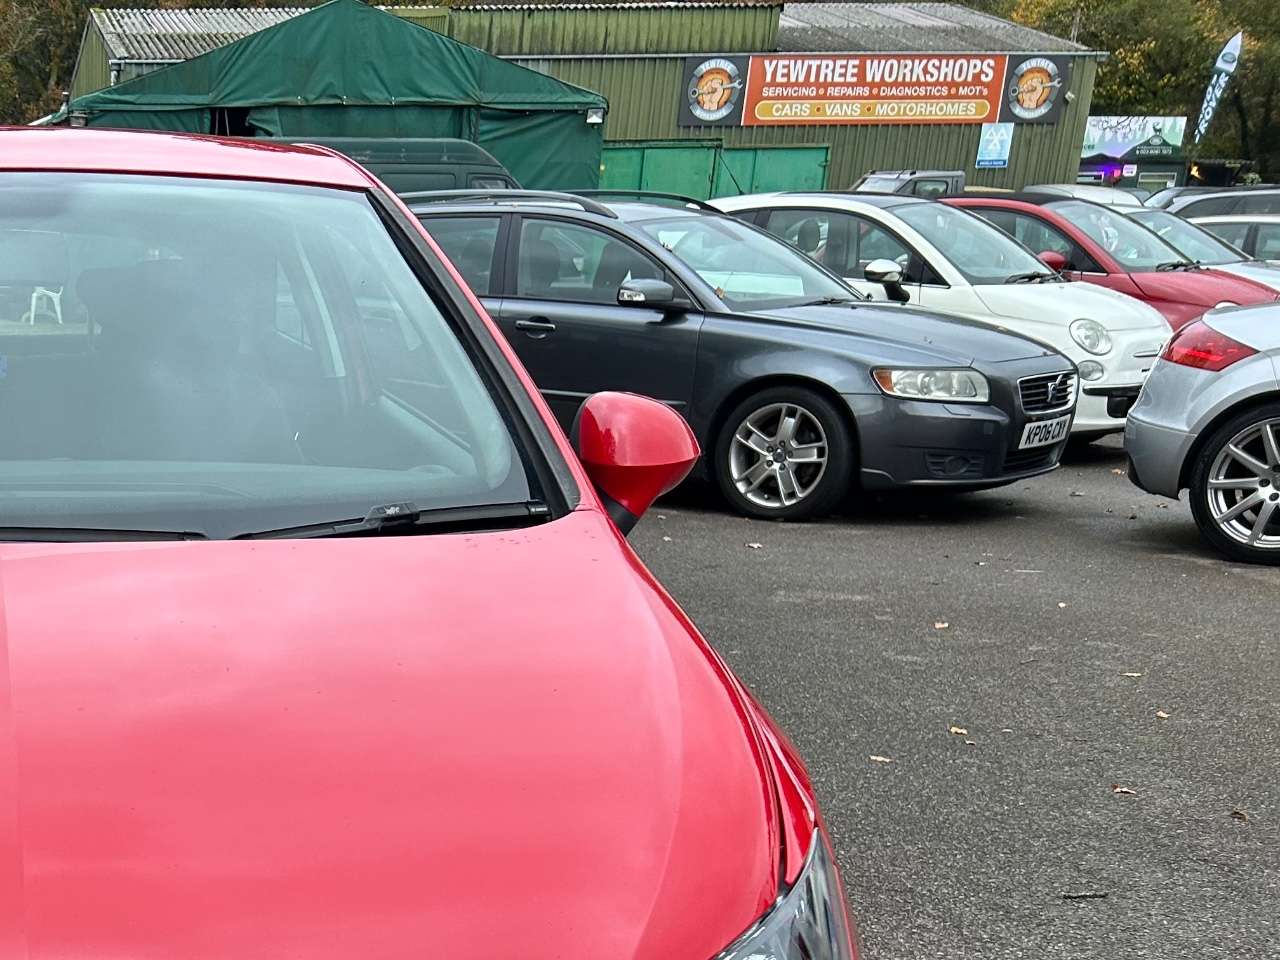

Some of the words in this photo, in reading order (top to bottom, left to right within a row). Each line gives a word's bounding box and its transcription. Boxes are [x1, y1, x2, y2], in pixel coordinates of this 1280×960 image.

[763, 60, 860, 83] YEWTREE
[865, 58, 995, 82] WORKSHOPS
[762, 87, 817, 97] SERVICING
[827, 86, 870, 96] REPAIRS
[880, 86, 948, 96] DIAGNOSTICS
[772, 103, 810, 117] CARS
[825, 103, 861, 116] VANS
[875, 102, 976, 116] MOTORHOMES
